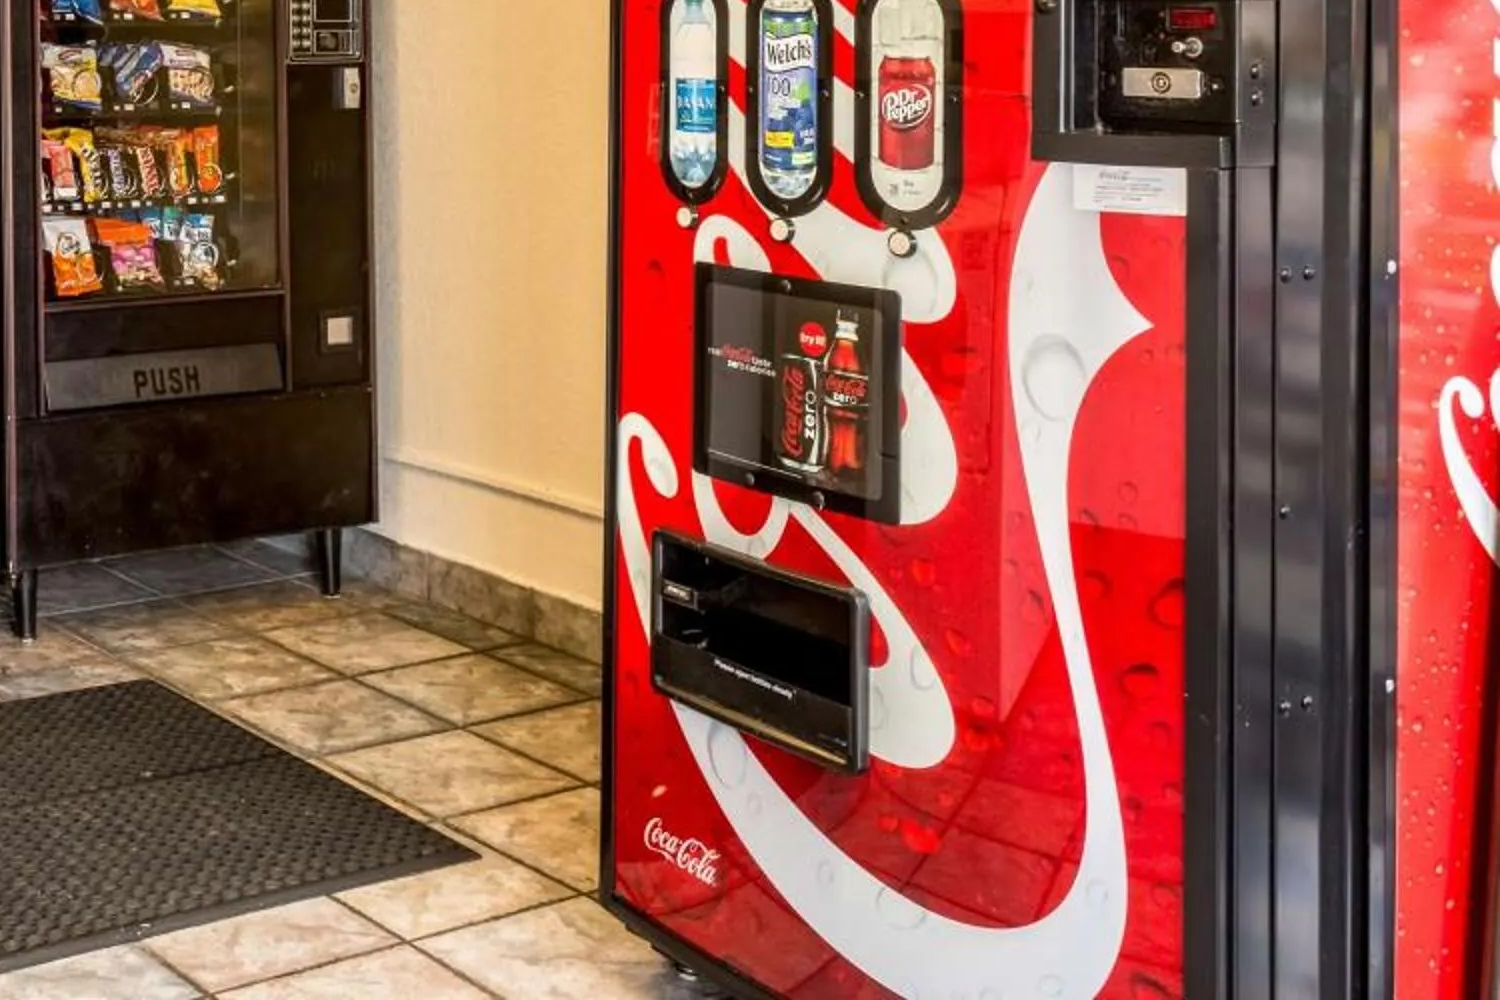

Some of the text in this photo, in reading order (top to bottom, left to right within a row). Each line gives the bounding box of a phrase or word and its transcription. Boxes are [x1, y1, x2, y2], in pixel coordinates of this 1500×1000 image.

[767, 39, 812, 65] Welch's
[884, 91, 928, 122] Pepper
[133, 366, 201, 398] PUSH
[833, 391, 858, 405] zero
[804, 390, 817, 440] zero
[644, 817, 721, 887] Coca-Cola
